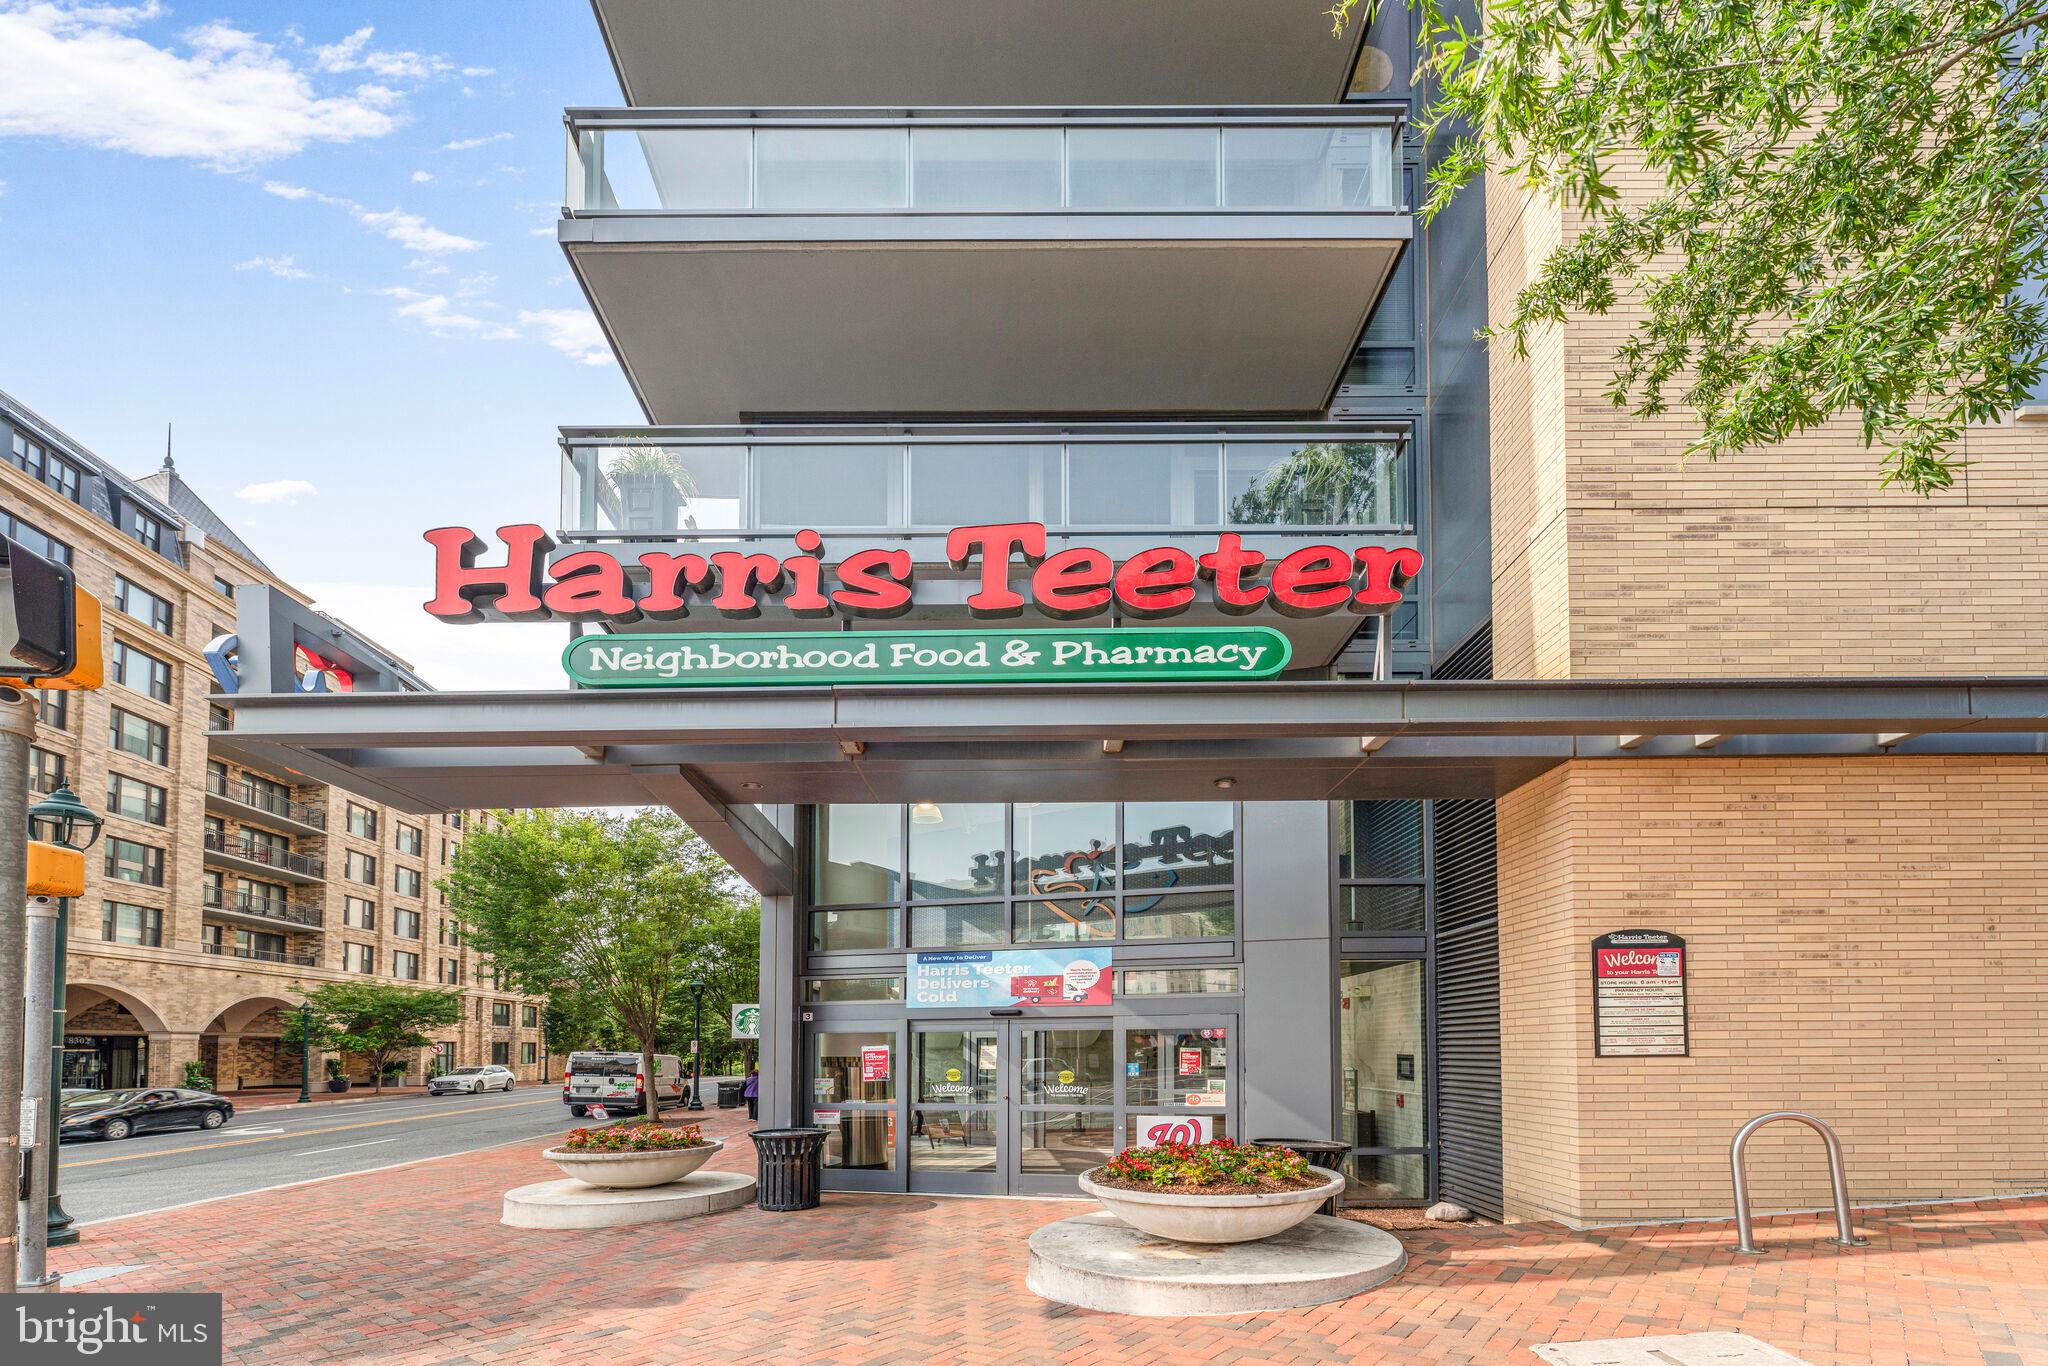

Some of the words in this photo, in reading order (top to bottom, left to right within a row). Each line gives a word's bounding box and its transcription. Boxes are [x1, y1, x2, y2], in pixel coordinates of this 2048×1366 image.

[423, 523, 914, 622] Harris
[946, 522, 1424, 618] Teeter
[590, 645, 880, 679] Neighborhood
[891, 643, 987, 668] Food
[1002, 640, 1038, 667] &
[1052, 641, 1268, 673] Pharmacy
[1604, 950, 1658, 967] Welcom
[917, 964, 970, 977] Harris
[974, 963, 1032, 975] Teeter
[917, 977, 991, 990] Delivers
[917, 990, 958, 1002] Cold
[931, 1082, 974, 1093] Welcome
[1041, 1083, 1089, 1094] Welcome
